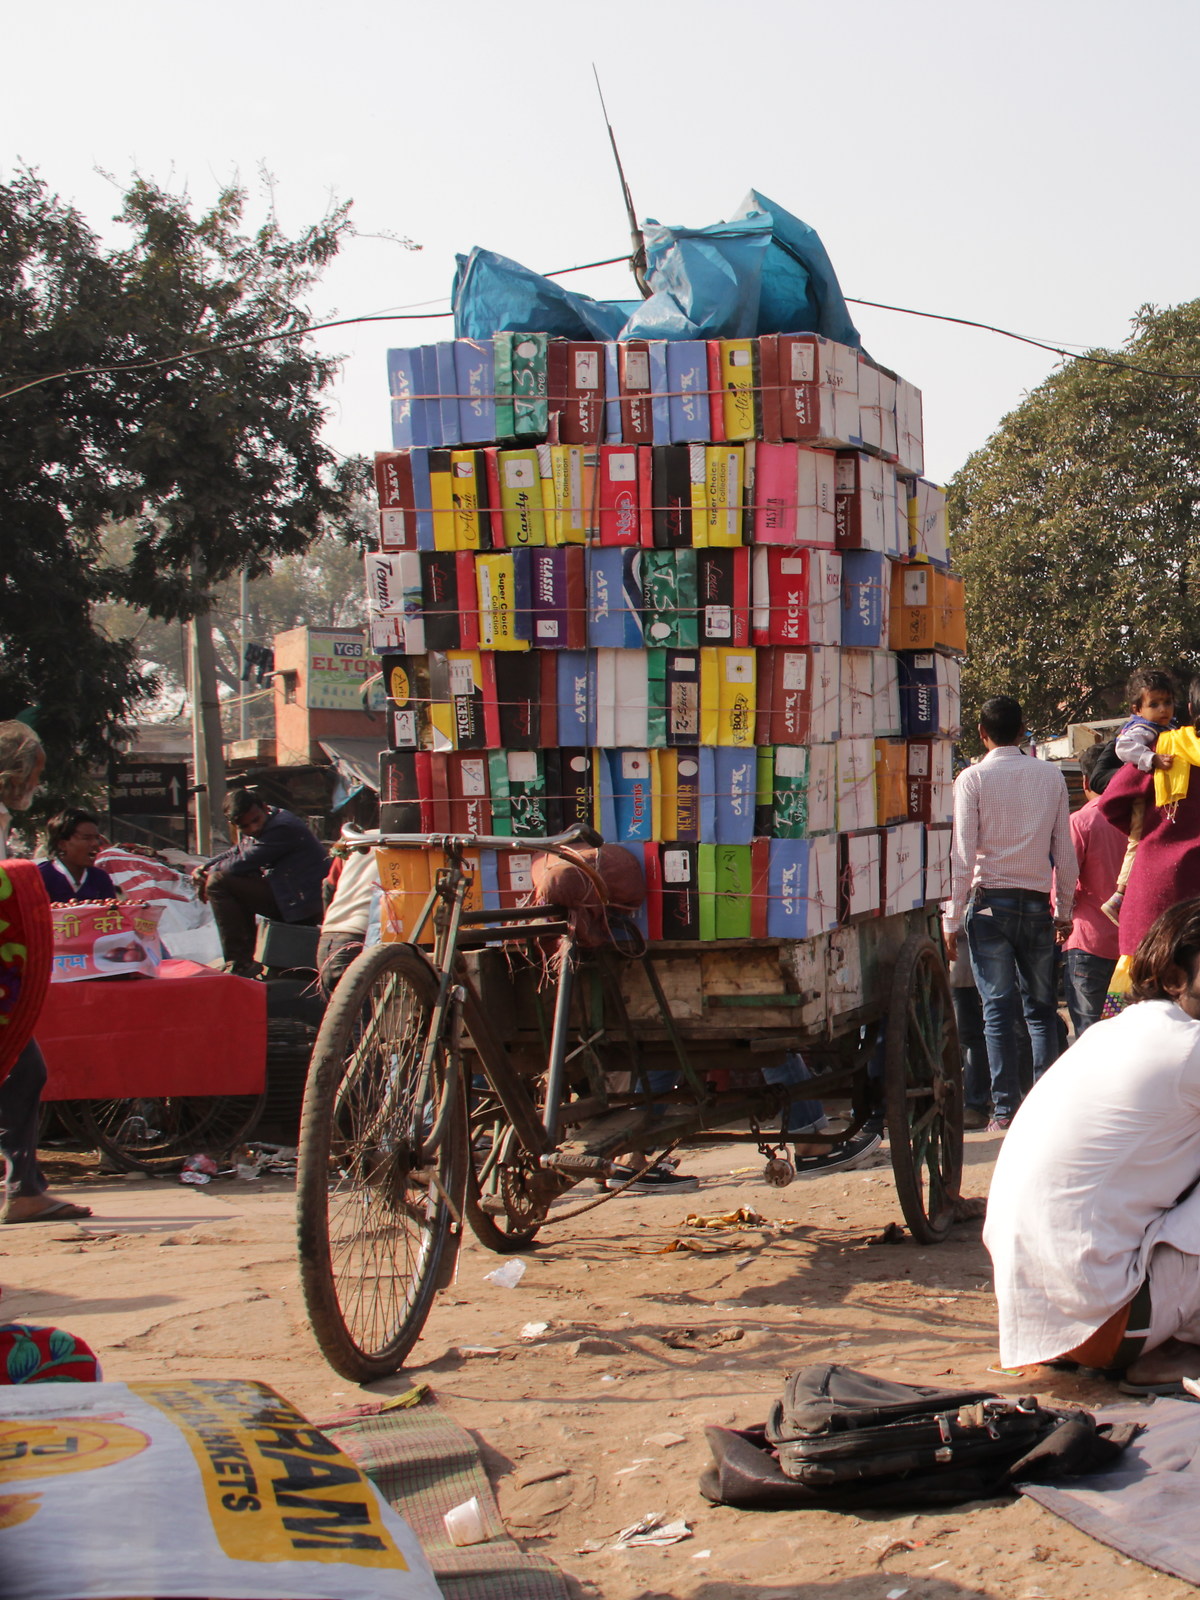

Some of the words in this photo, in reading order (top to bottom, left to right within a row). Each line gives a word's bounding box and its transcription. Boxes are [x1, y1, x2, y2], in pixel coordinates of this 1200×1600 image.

[469, 363, 483, 417] AFK
[795, 383, 806, 424] AFK
[579, 391, 590, 433] AFK
[387, 463, 400, 505] AFK
[516, 491, 530, 543] Candy
[766, 498, 777, 528] MASTR
[836, 496, 848, 536] AFK
[376, 559, 395, 610] Tennis
[498, 572, 506, 600] Super
[543, 557, 554, 602] CLASSIC
[595, 570, 609, 623] AFK
[826, 573, 841, 585] KICK
[491, 595, 499, 635] Collection
[788, 591, 799, 638] KICK
[859, 576, 873, 626] AFK
[335, 643, 362, 656] YG6
[457, 696, 469, 739] TIGER
[573, 672, 587, 723] AFK
[733, 703, 742, 731] BOLD
[784, 692, 798, 733] AFK
[632, 783, 644, 825] Tennis
[731, 763, 747, 816] AFK
[466, 798, 478, 836] AFK
[677, 809, 692, 831] NEW
[781, 863, 797, 915] AFK
[93, 910, 125, 933] की
[52, 954, 89, 972] रम
